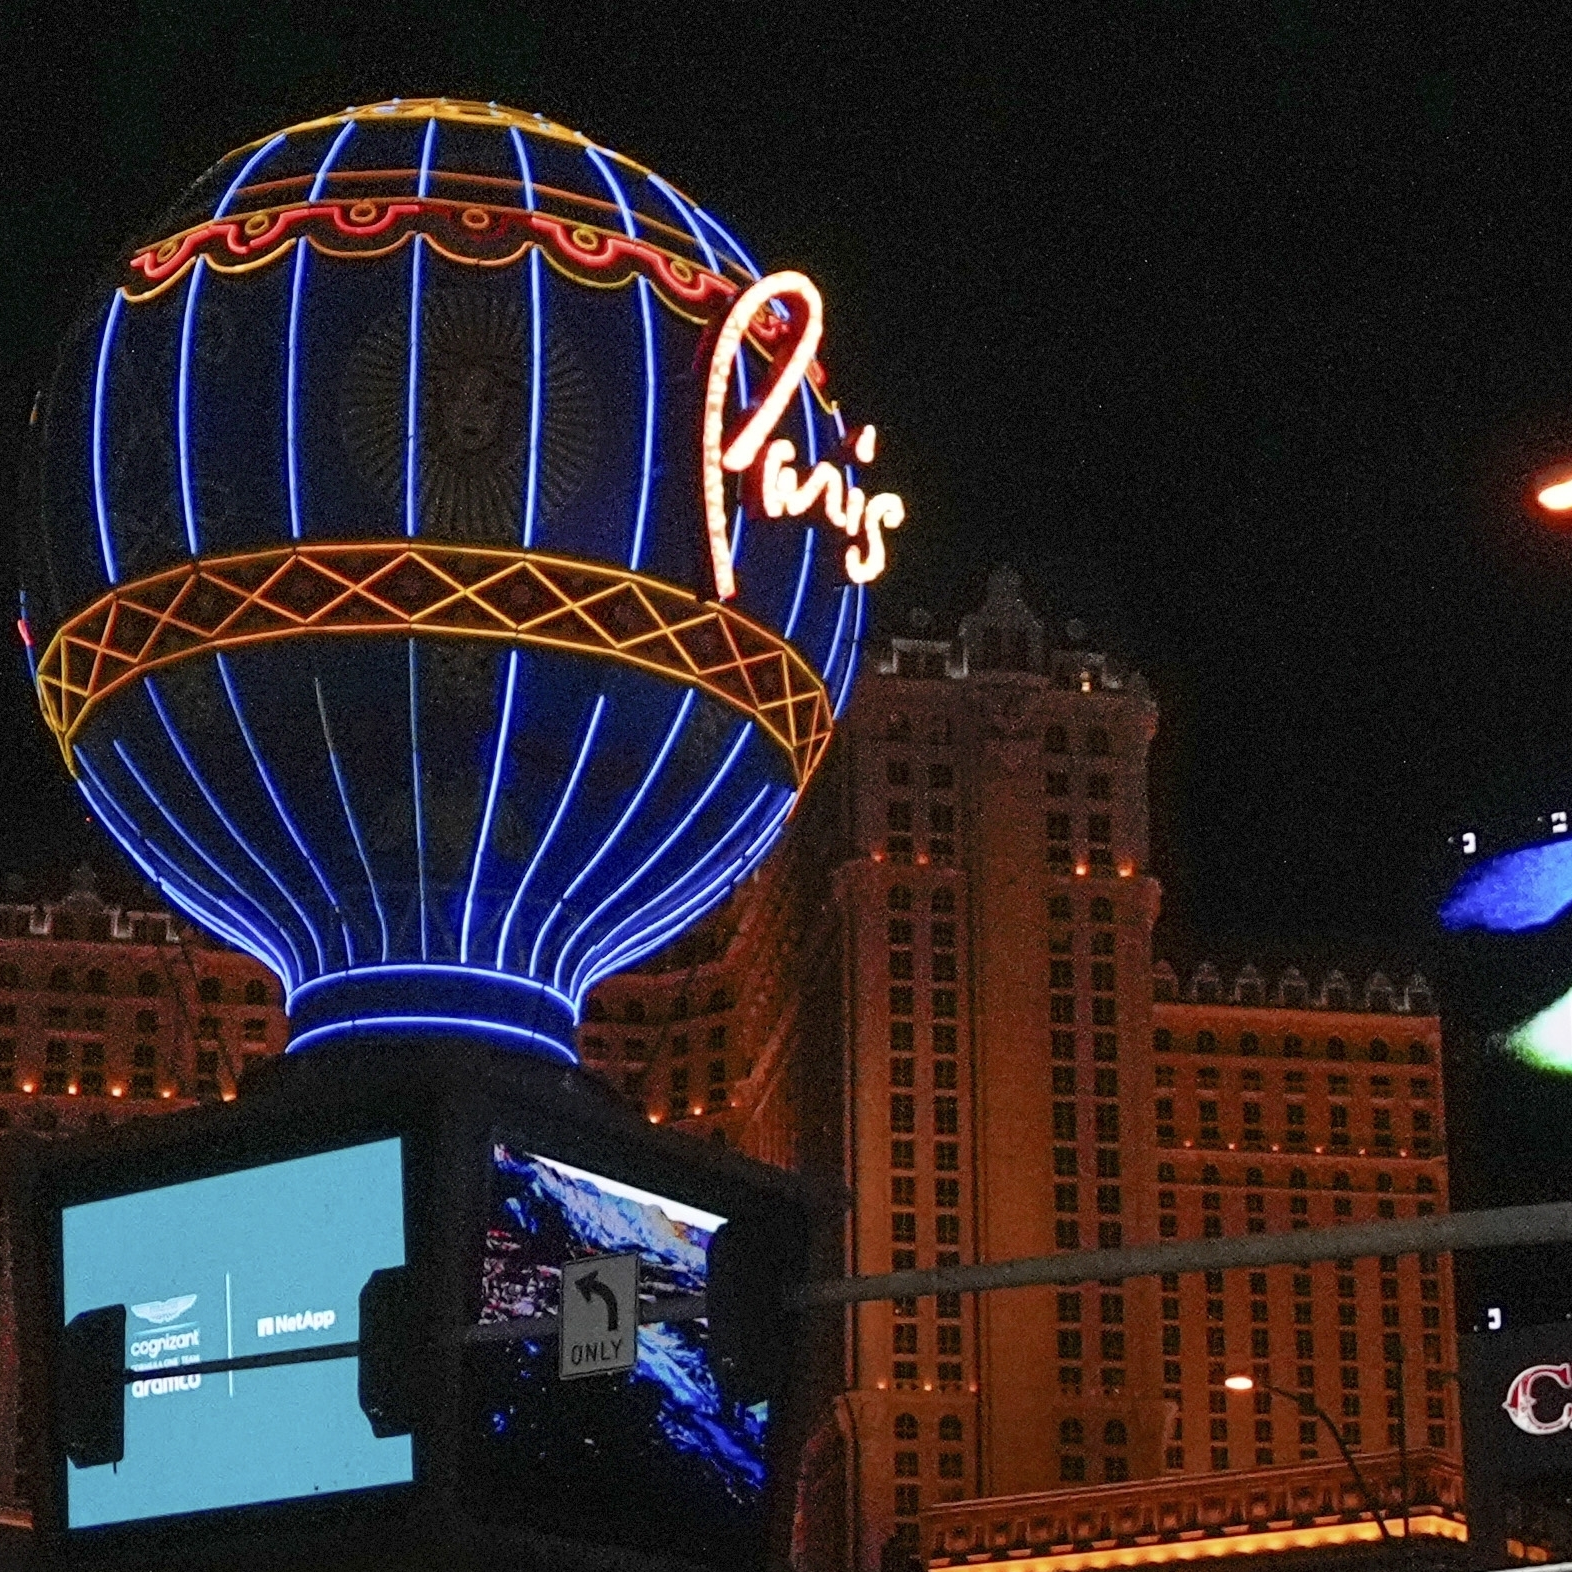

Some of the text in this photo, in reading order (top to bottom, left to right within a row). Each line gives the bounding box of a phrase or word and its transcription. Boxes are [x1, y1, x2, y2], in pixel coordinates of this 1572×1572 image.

[703, 270, 905, 598] Paris
[276, 1309, 335, 1333] NetApp
[130, 1329, 200, 1358] cognizant
[571, 1339, 622, 1366] ONLY
[132, 1373, 201, 1398] aramco
